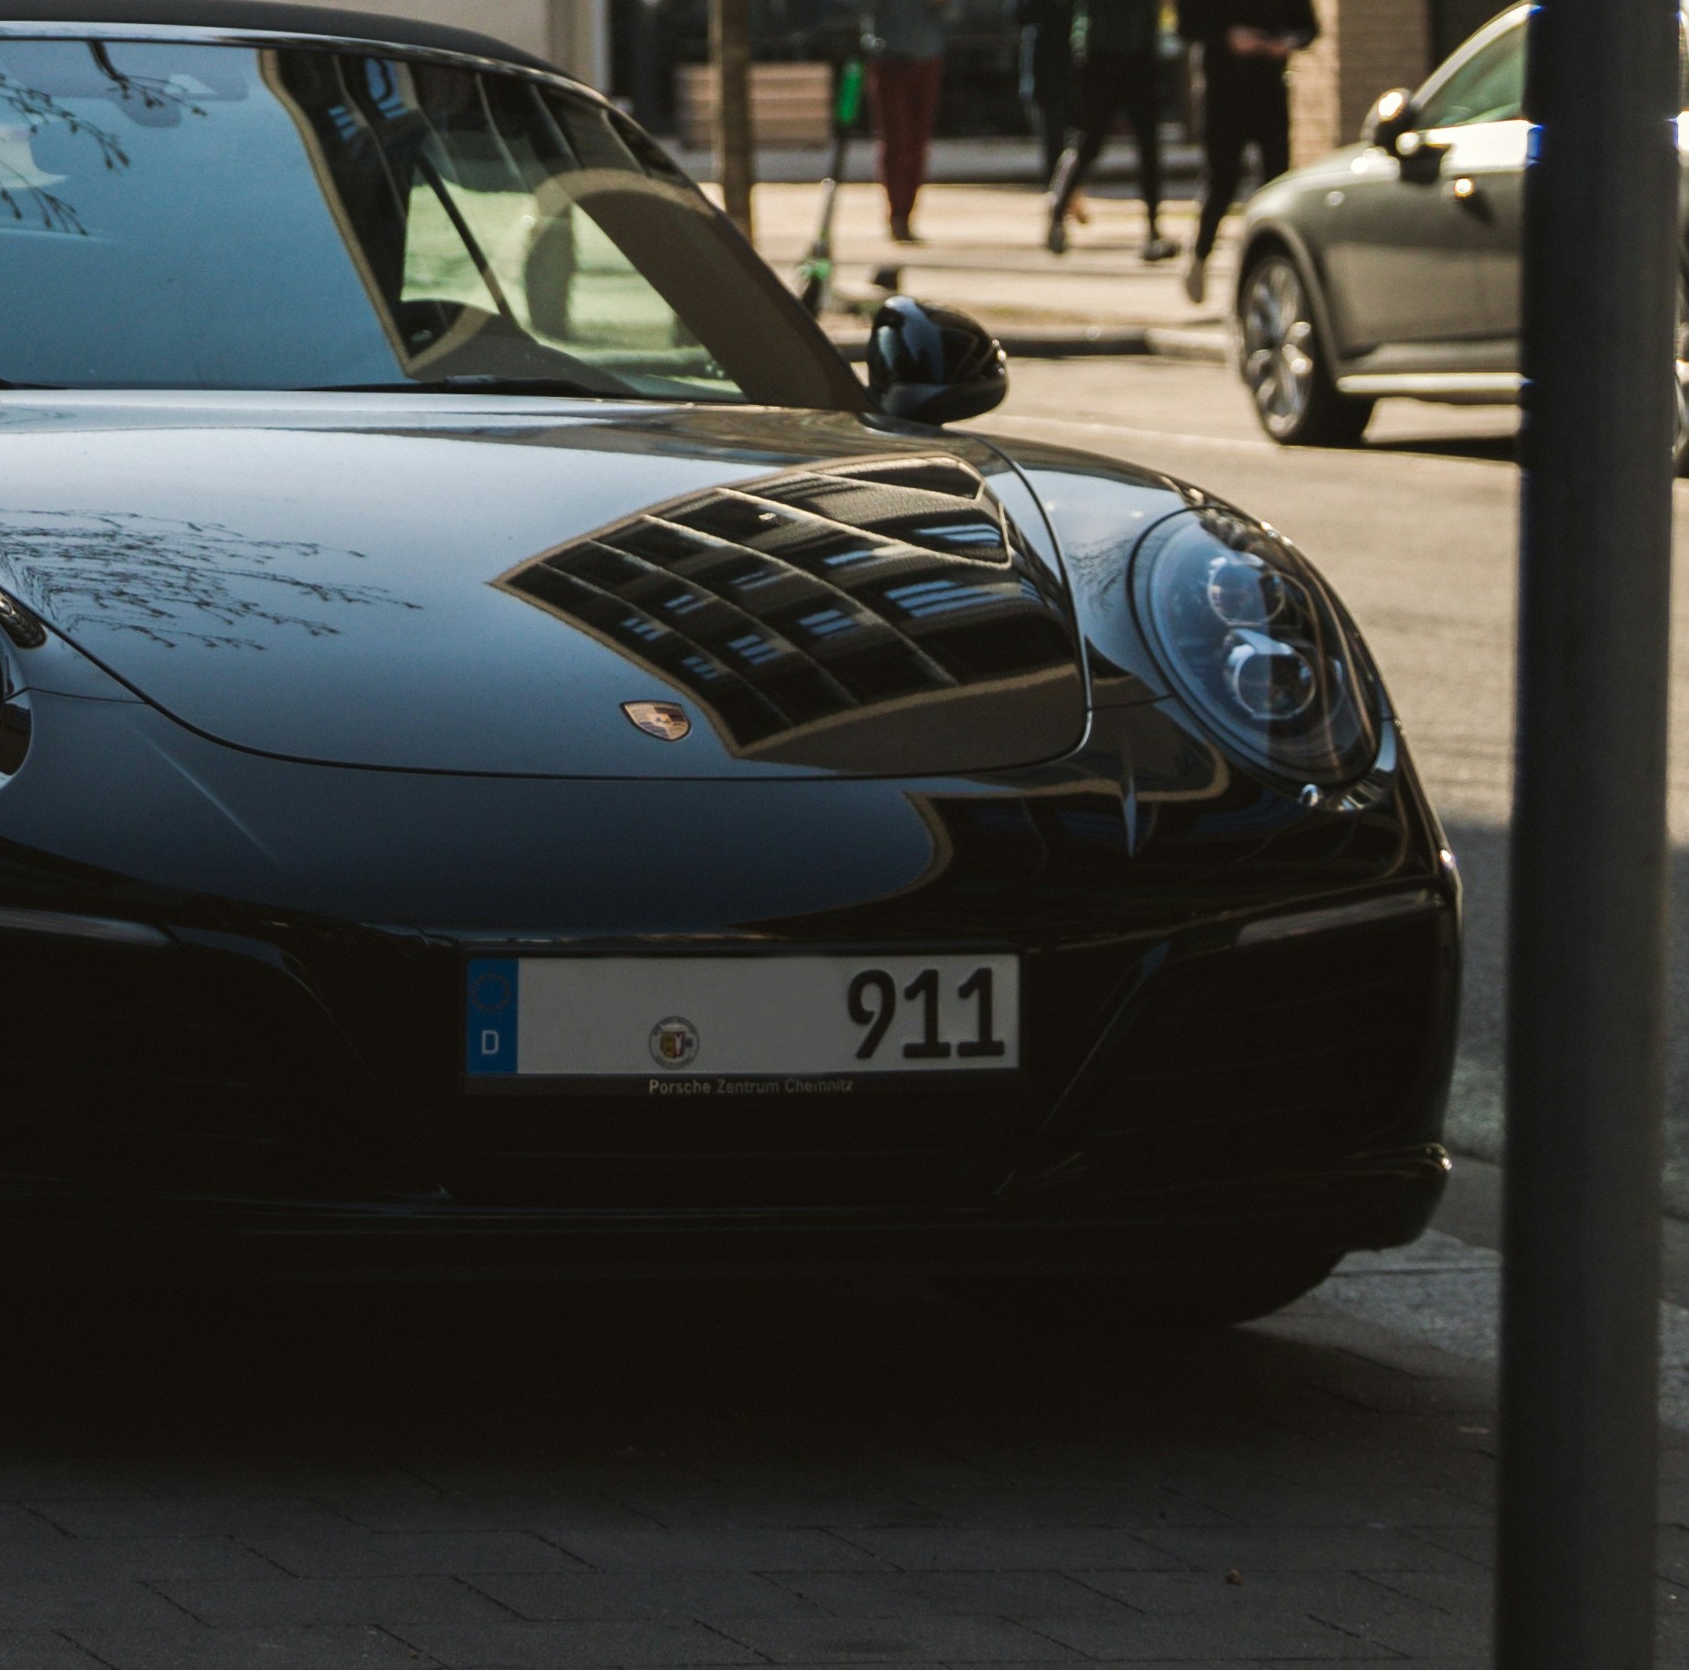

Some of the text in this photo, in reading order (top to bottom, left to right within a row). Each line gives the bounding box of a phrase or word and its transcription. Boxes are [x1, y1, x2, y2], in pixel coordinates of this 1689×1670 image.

[847, 967, 1005, 1059] 911
[481, 1028, 500, 1055] D
[648, 1077, 855, 1095] Porsche Zentrum Chemnitz
